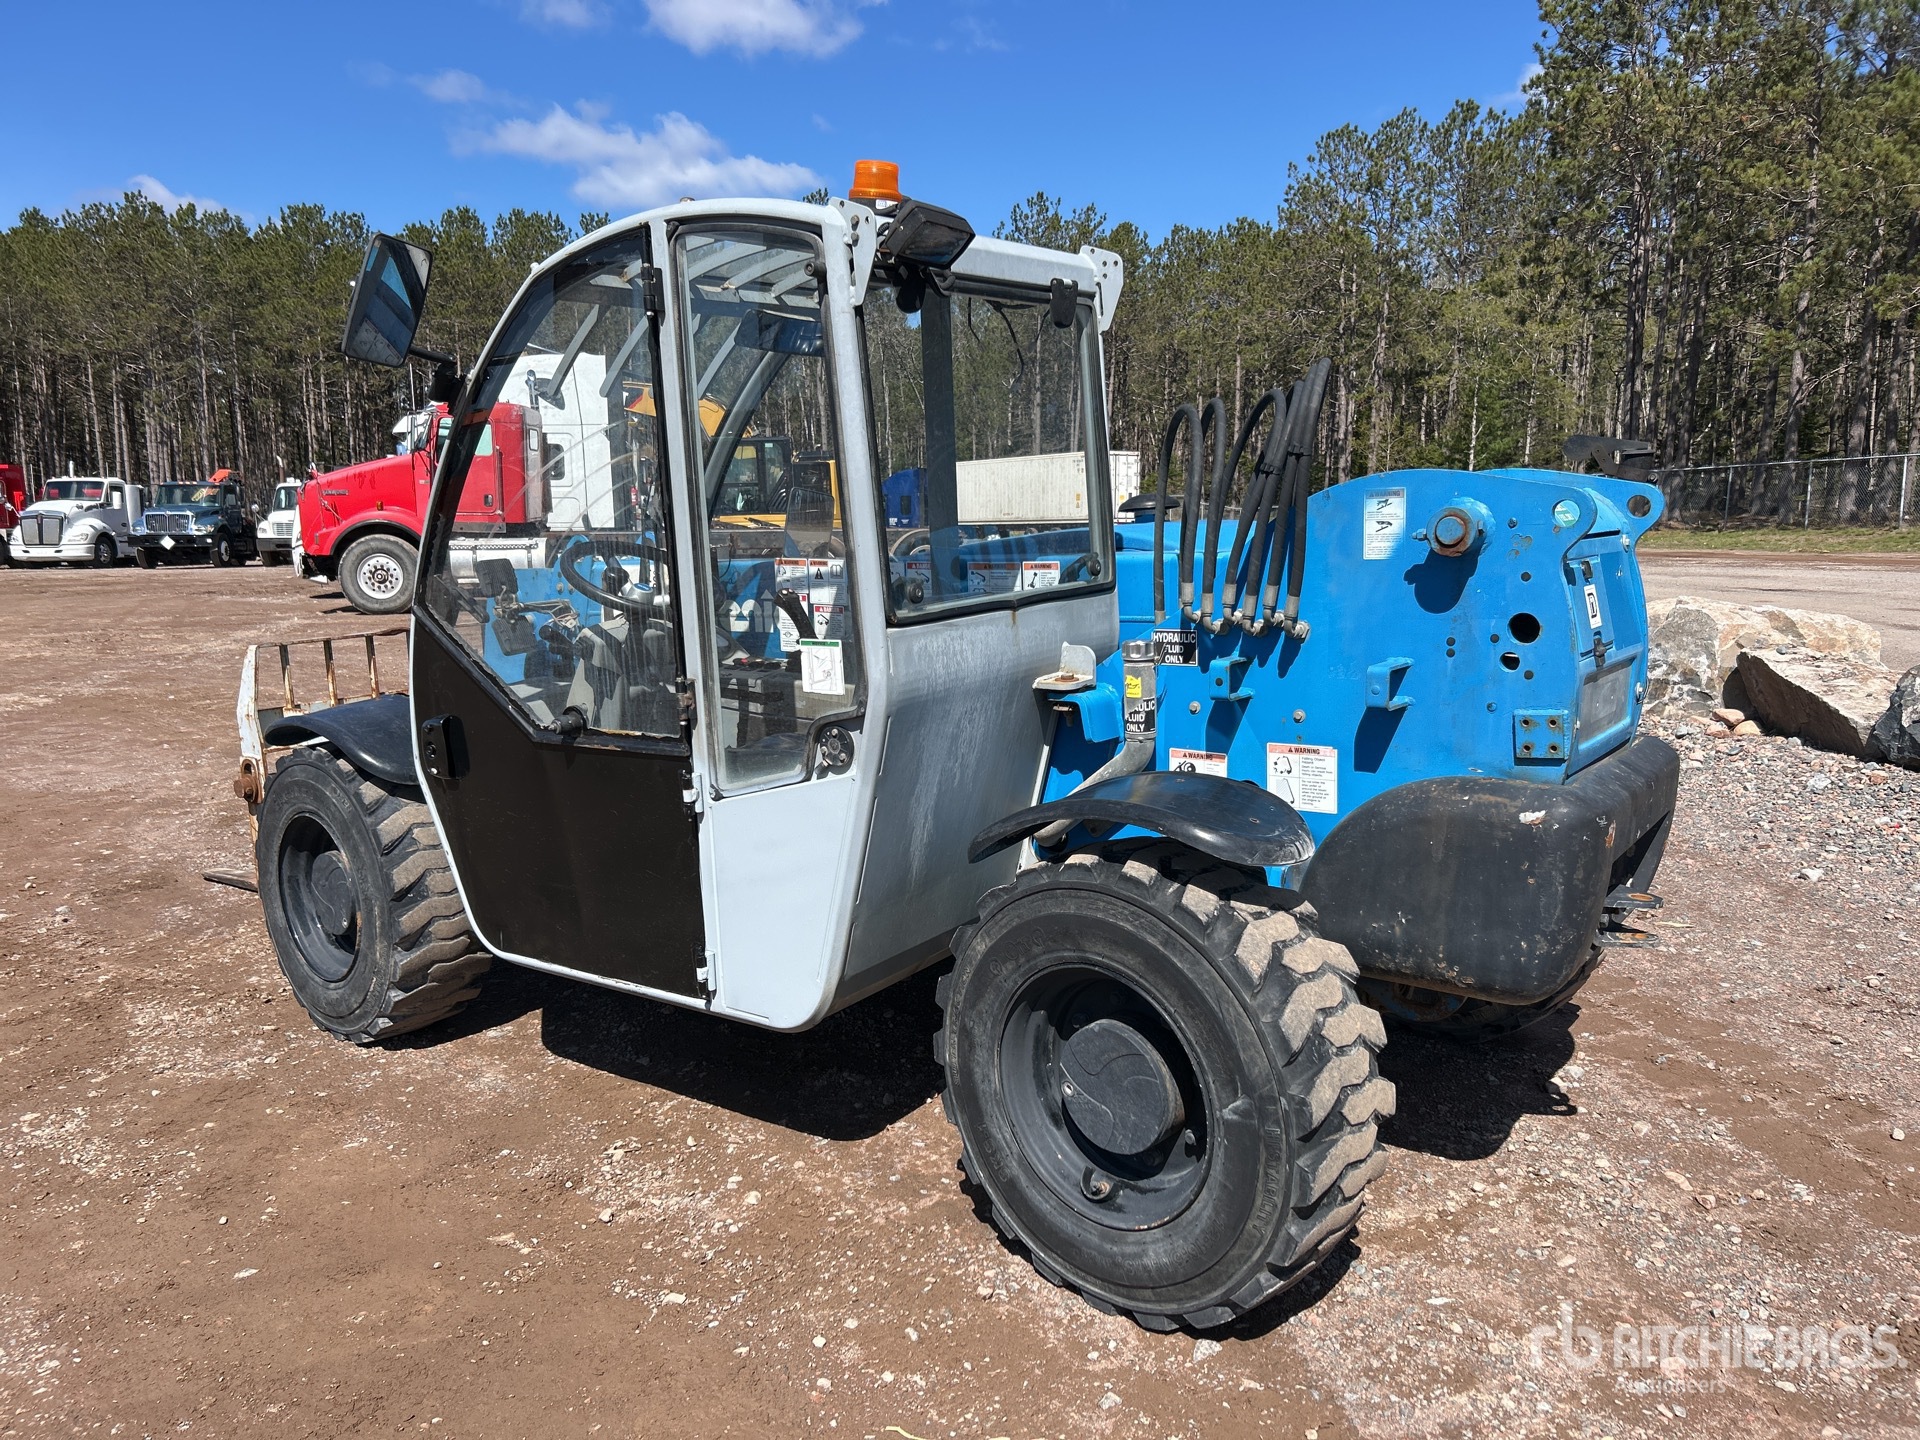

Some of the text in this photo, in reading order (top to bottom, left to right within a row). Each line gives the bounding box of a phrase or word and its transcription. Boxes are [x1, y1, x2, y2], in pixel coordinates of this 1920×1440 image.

[1153, 632, 1196, 643] HYDRAULIC
[1164, 644, 1184, 653] FLUID
[1164, 655, 1184, 663] ONLY
[1126, 723, 1145, 732] ONLY
[1294, 747, 1320, 755] WARNING
[1188, 752, 1213, 760] WARNING
[1251, 1151, 1280, 1236] STABILITY
